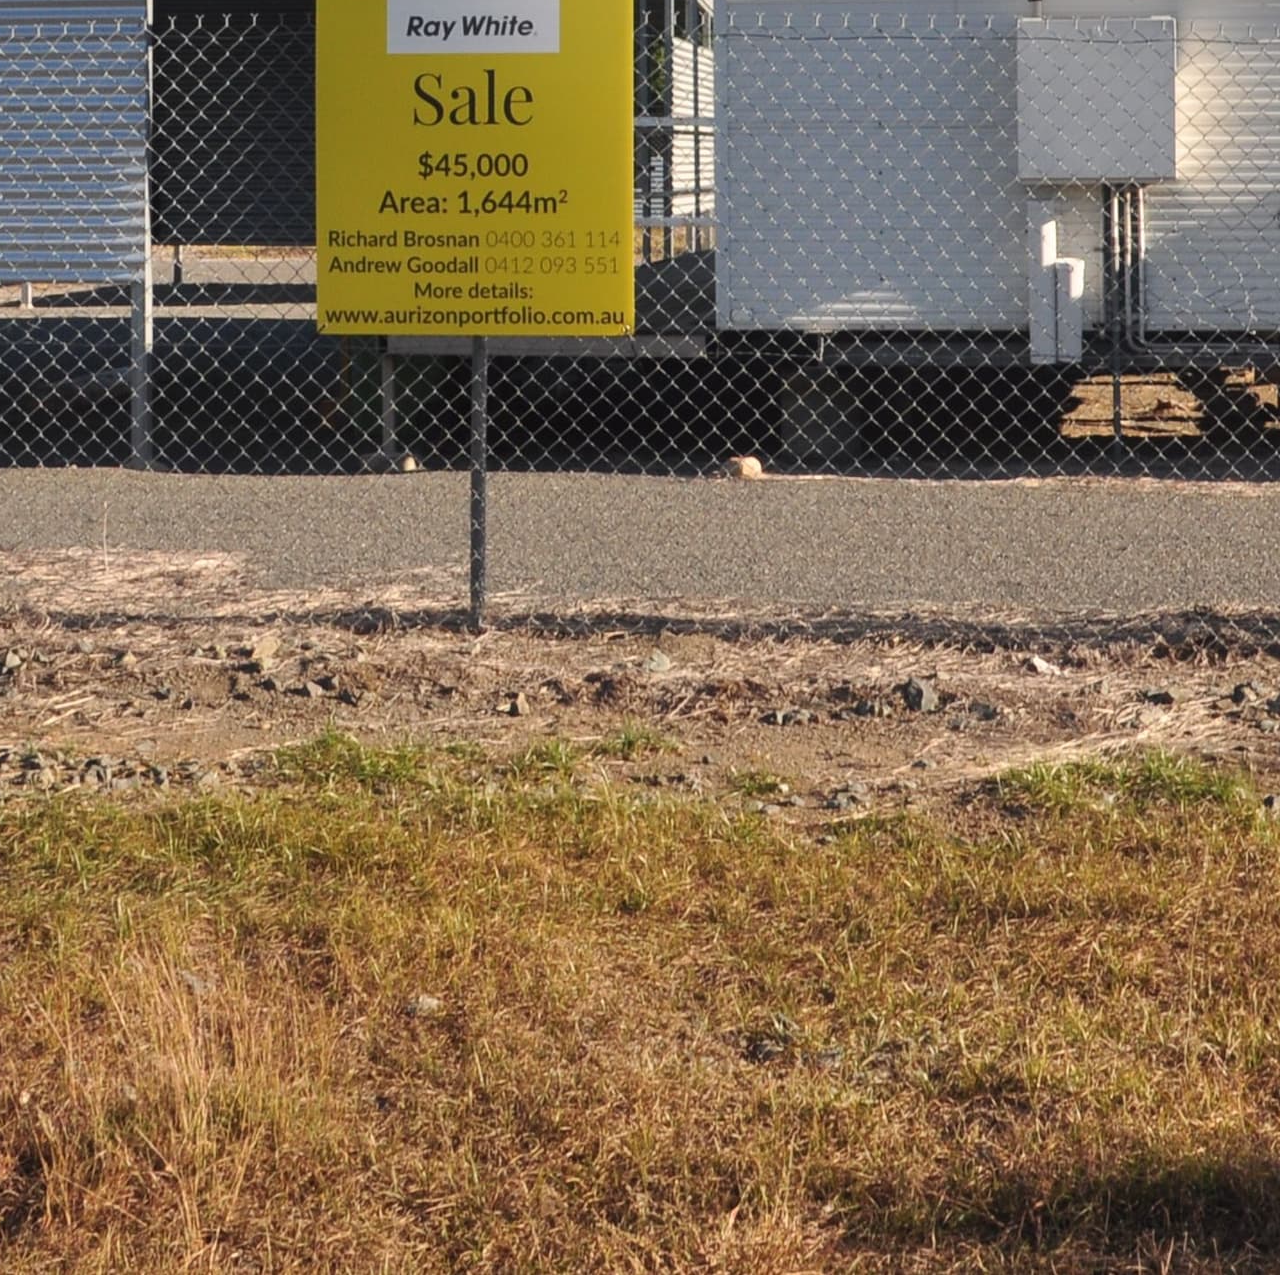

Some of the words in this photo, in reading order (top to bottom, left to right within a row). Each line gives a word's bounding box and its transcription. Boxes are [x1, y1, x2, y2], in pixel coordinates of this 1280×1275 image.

[406, 15, 456, 39] Ray
[462, 15, 533, 37] White
[413, 69, 534, 126] Sale
[418, 152, 529, 180] $45,000
[378, 190, 448, 214] Area:
[328, 229, 398, 248] Richard
[403, 230, 480, 248] Brosnan
[485, 230, 536, 248] 0400
[540, 230, 576, 248] 361
[584, 229, 621, 248] 114
[328, 256, 402, 274] Andrew
[407, 256, 479, 274] Goodall
[485, 256, 534, 274] 0412
[540, 256, 577, 274] 093
[583, 256, 619, 274] 551
[414, 282, 463, 299] More
[468, 281, 533, 300] details:
[325, 305, 624, 328] www.aurizonportfolio.com.au
